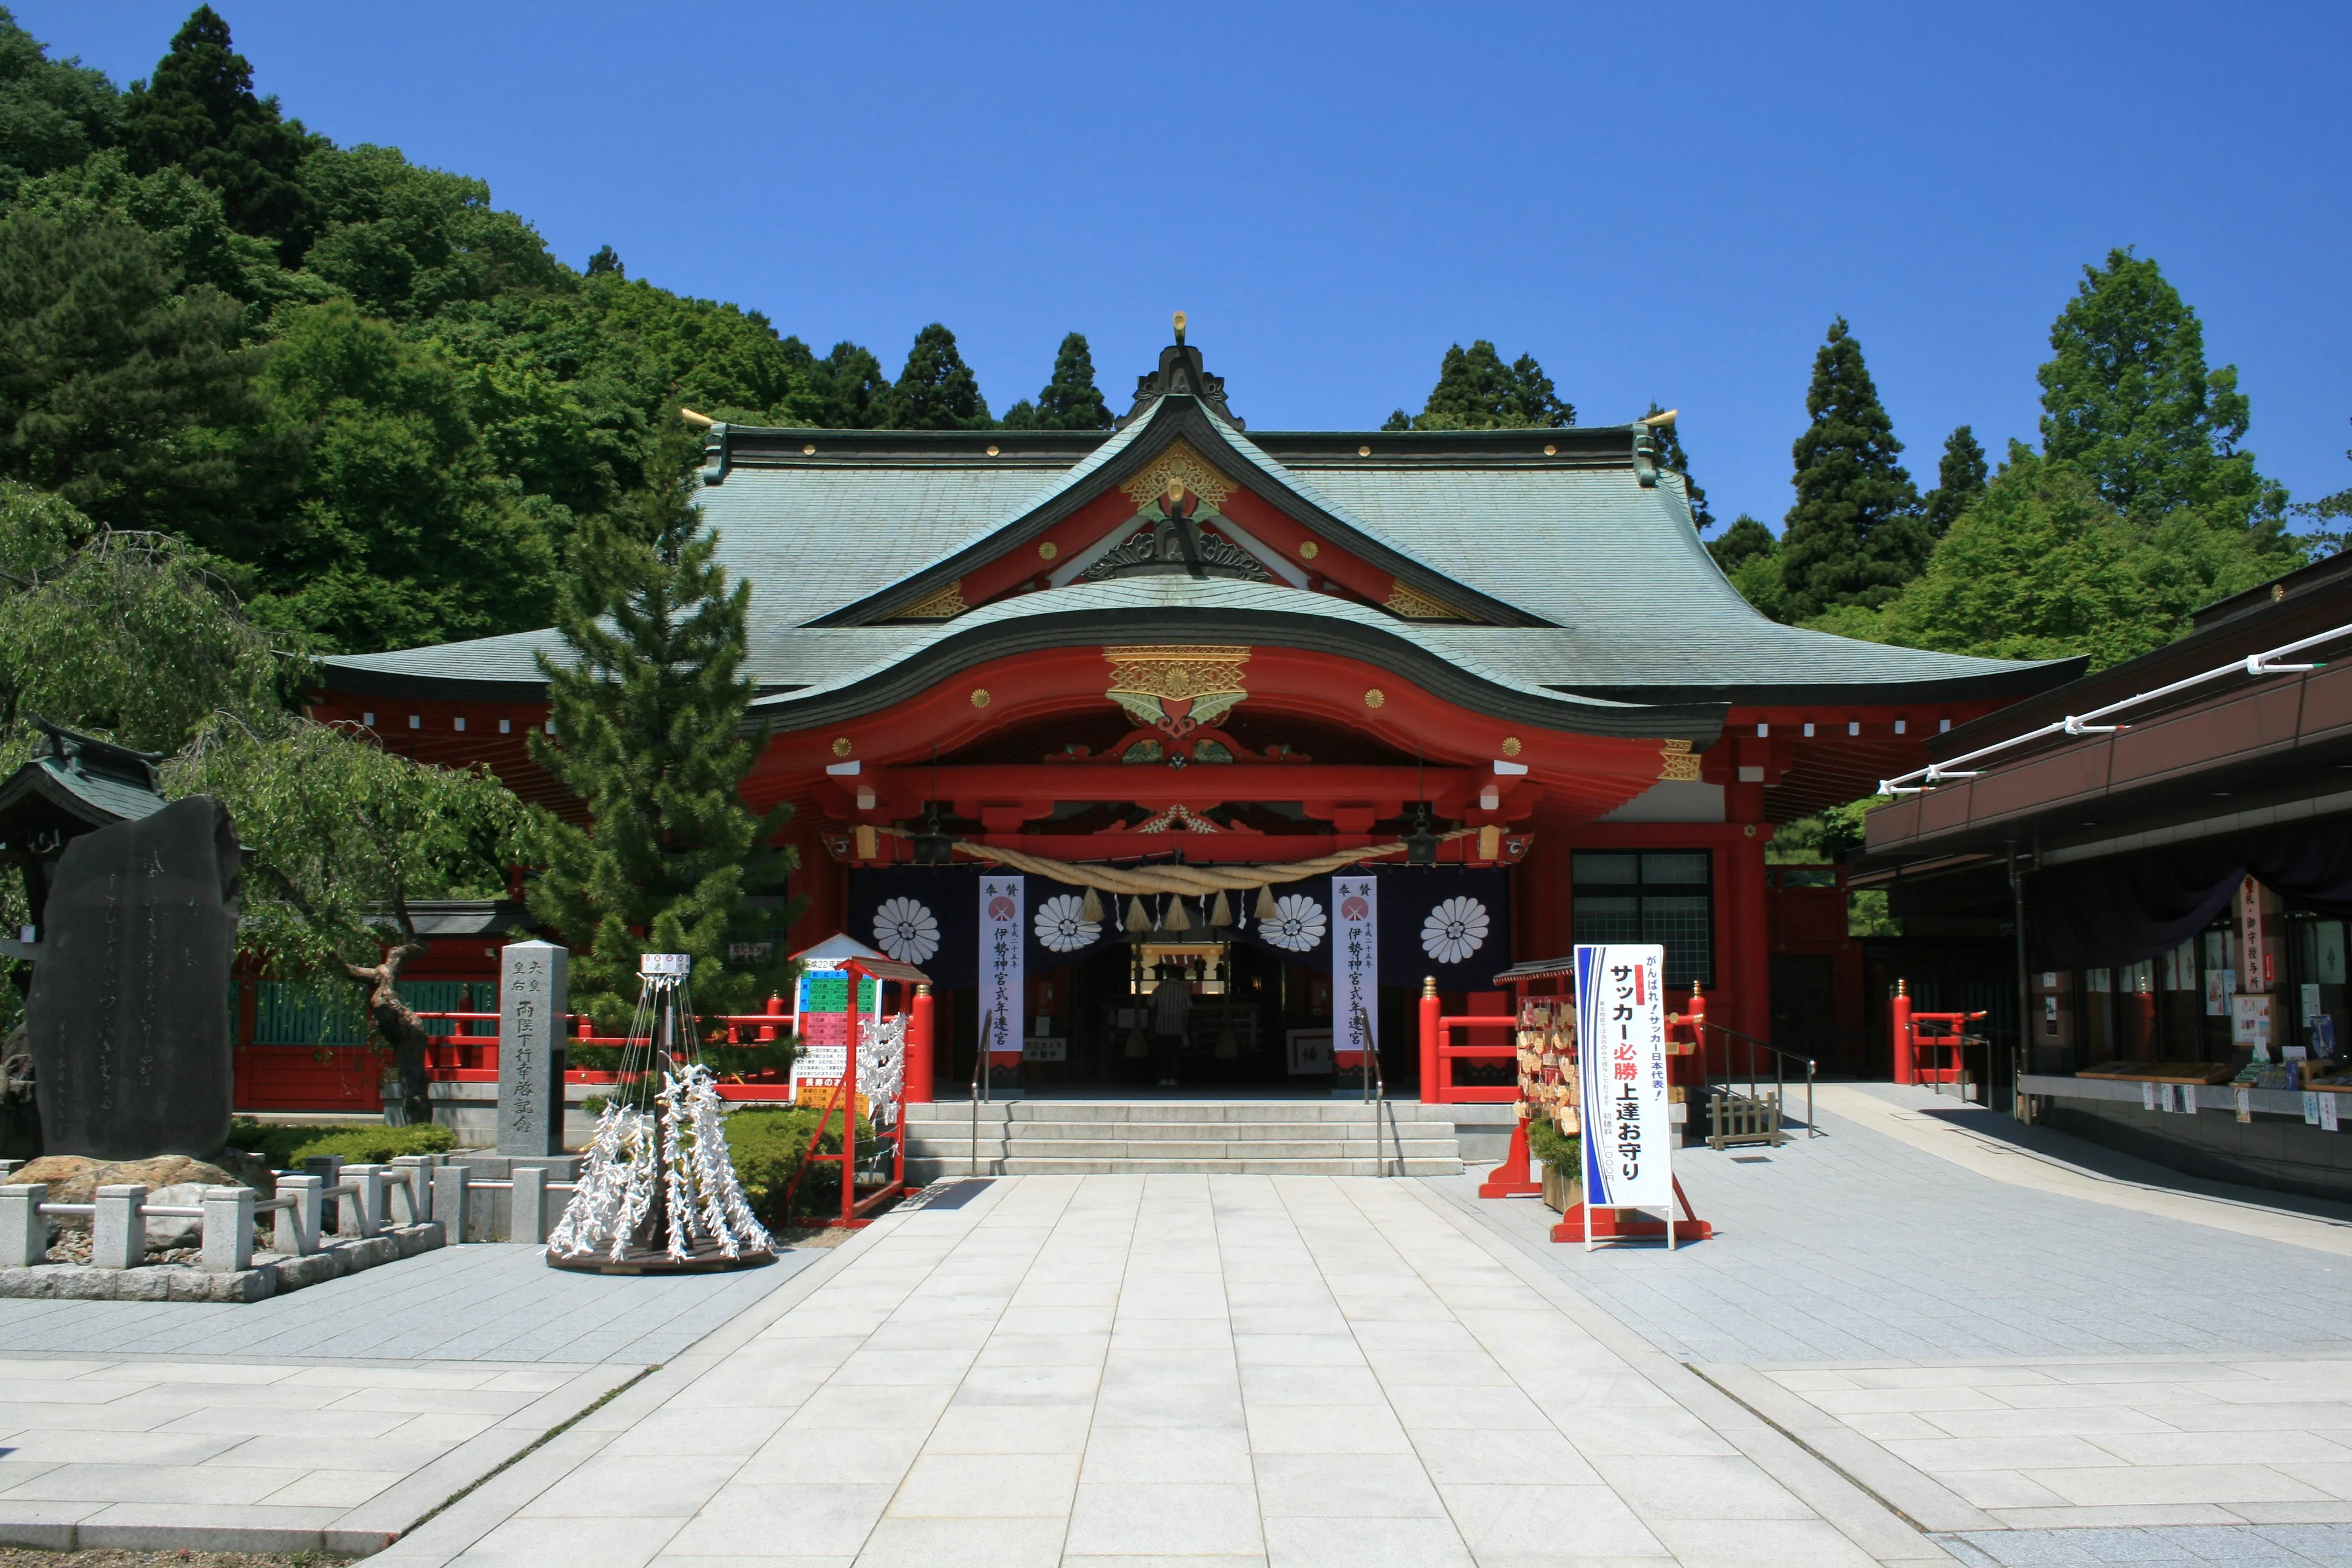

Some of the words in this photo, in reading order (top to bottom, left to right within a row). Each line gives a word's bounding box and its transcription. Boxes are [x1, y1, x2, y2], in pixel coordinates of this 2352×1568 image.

[1011, 922, 1019, 969] 平成二十五年
[1364, 922, 1373, 969] 平成二十五年
[511, 961, 526, 991] 皇后
[528, 961, 544, 992] 天皇
[993, 927, 1009, 1045] 伊勢神宮式年遷宮
[1348, 927, 1364, 1045] 伊勢神宮式年遷宮
[1610, 965, 1642, 1181] サッカー必勝上達お守り
